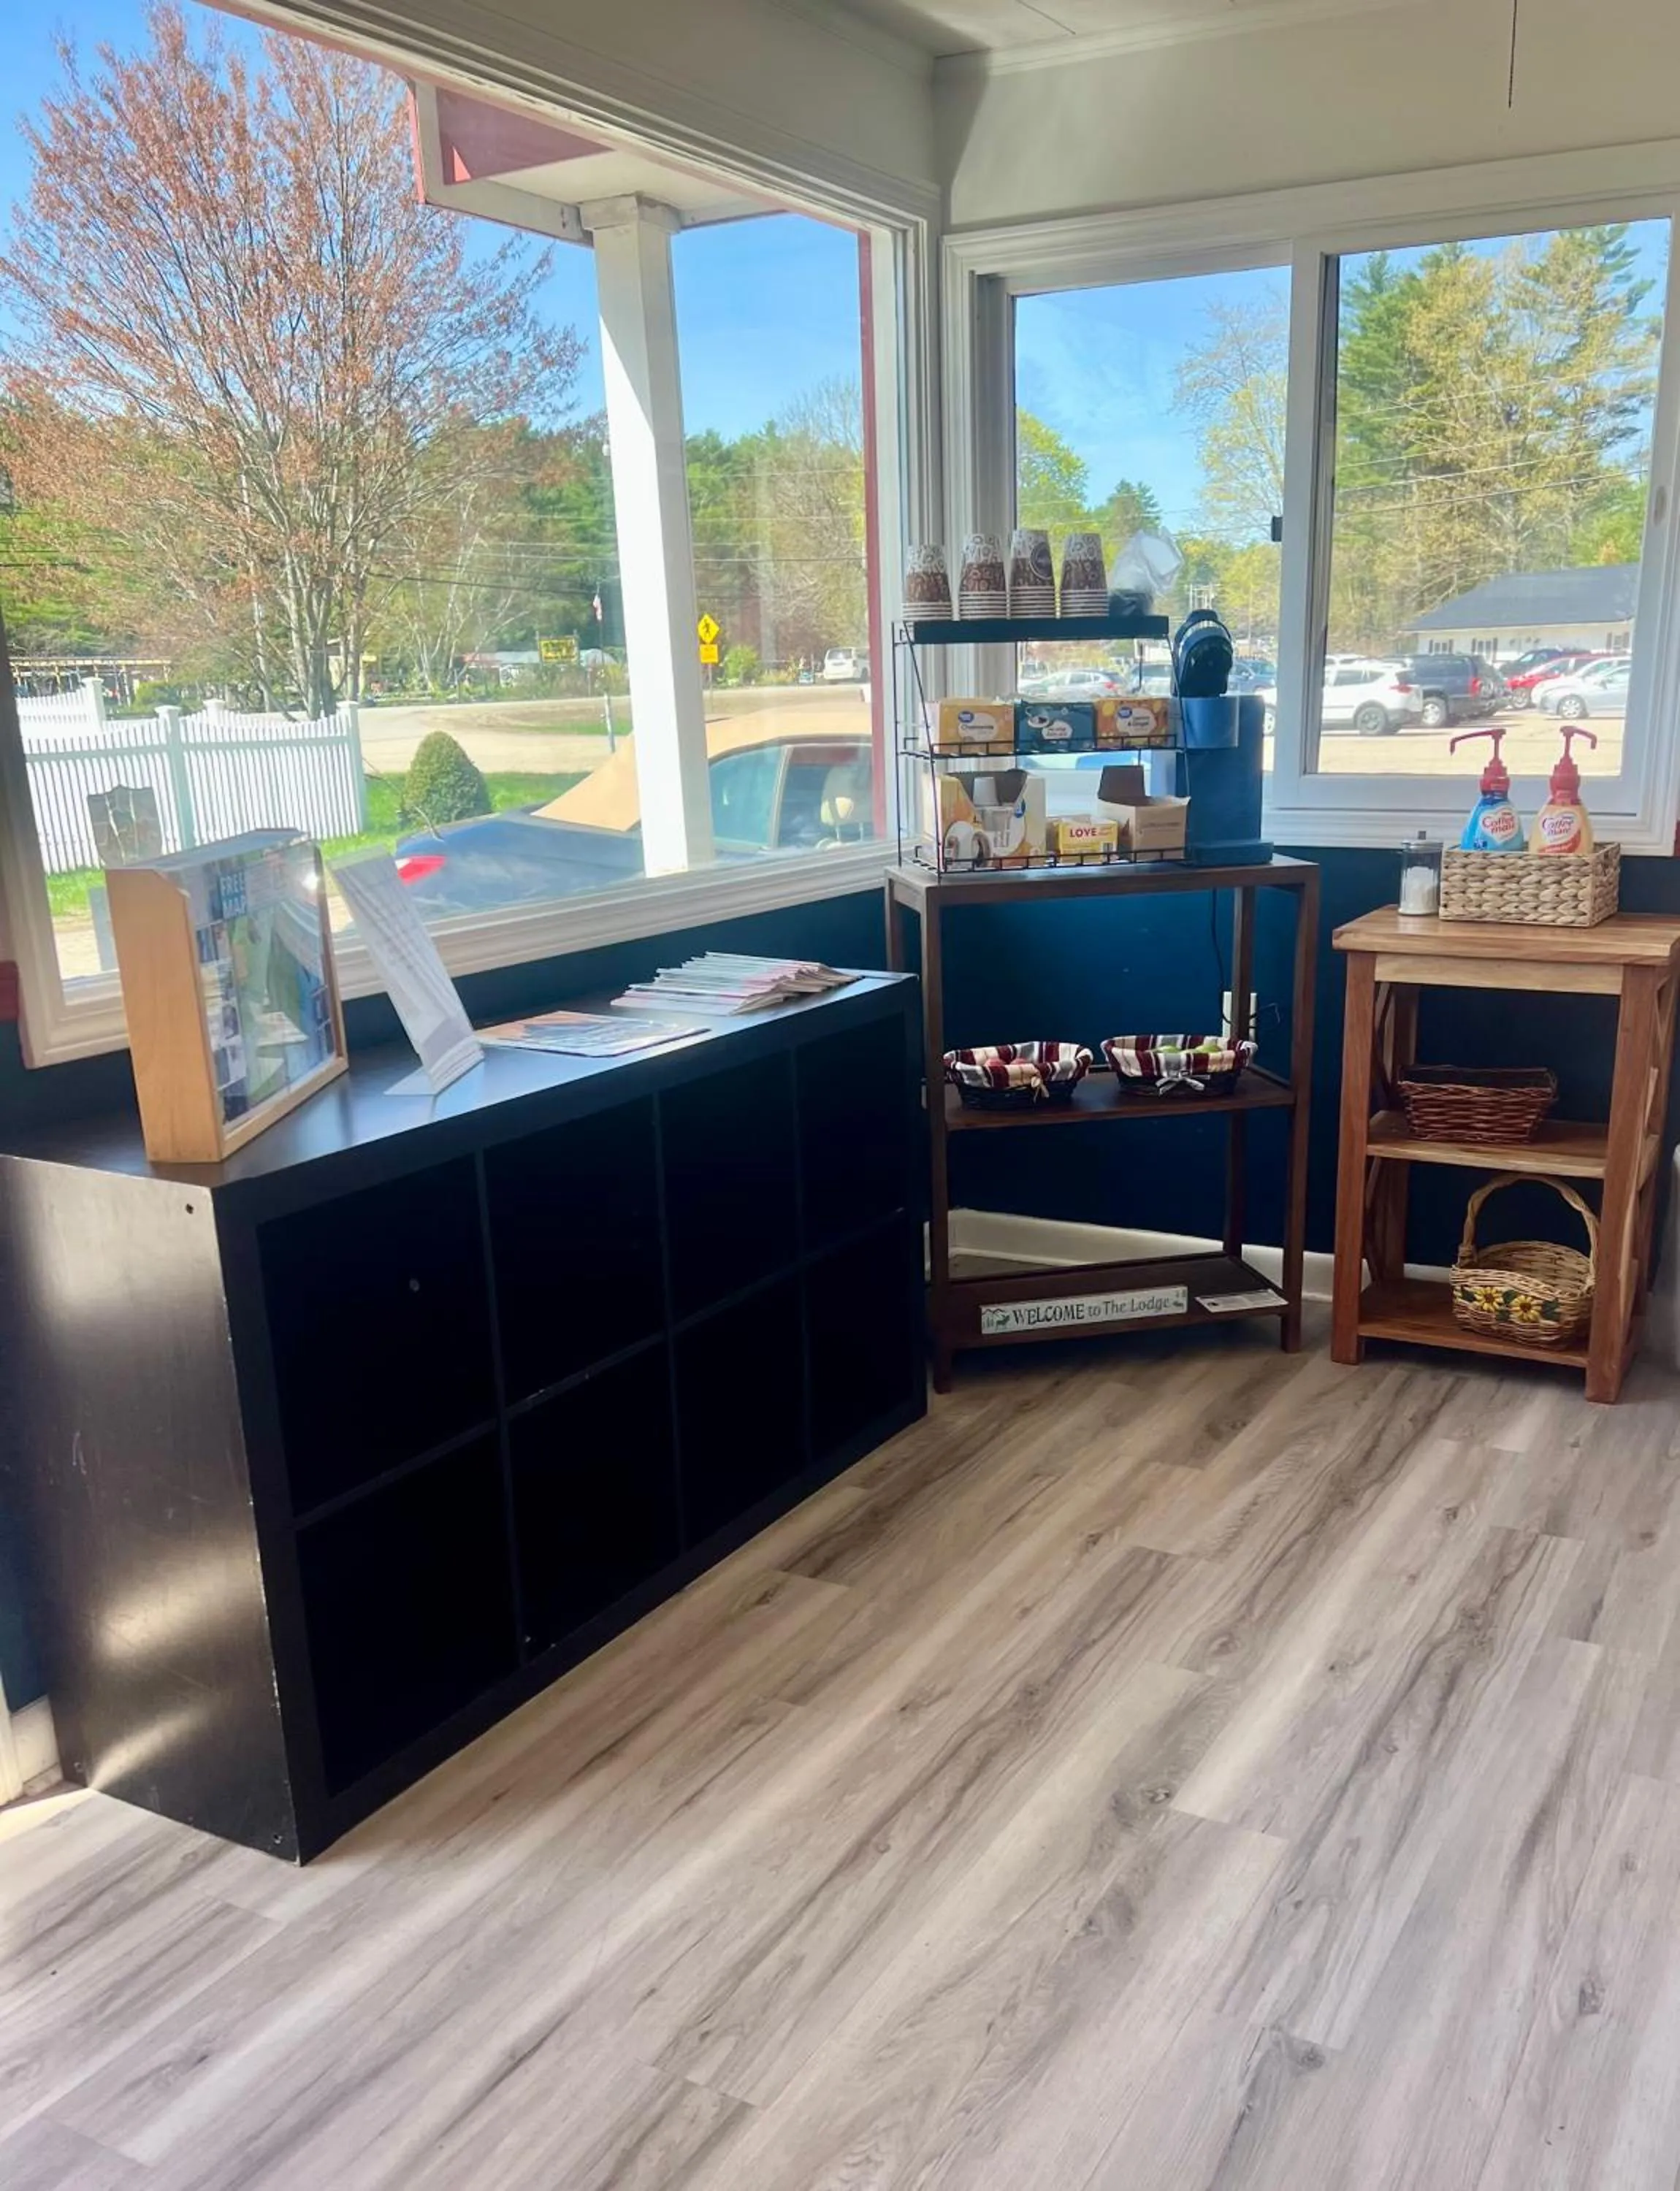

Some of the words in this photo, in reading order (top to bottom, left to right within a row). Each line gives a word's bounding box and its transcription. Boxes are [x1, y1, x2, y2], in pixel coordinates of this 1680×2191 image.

[1069, 827, 1096, 838] LOVE
[221, 872, 244, 897] FREE
[222, 895, 246, 919] MAP
[1012, 1304, 1085, 1326] WELCOME
[1088, 1305, 1101, 1317] to
[1103, 1299, 1126, 1315] The
[1130, 1296, 1169, 1312] Lodge
